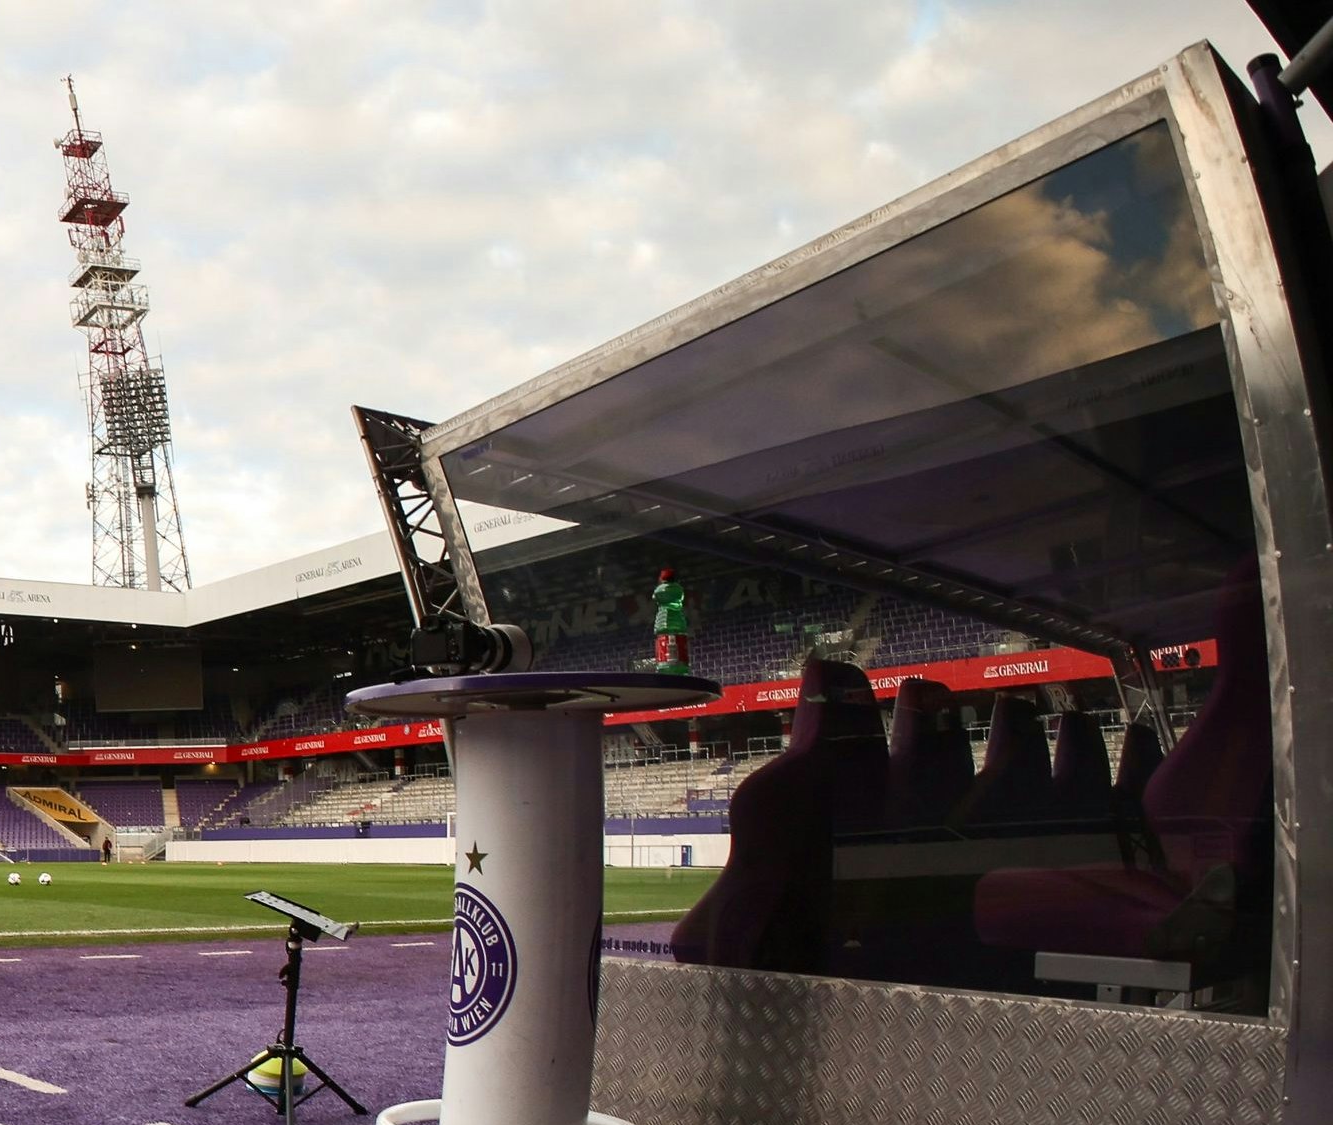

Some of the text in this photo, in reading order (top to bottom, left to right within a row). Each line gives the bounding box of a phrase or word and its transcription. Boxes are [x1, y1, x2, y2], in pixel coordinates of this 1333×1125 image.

[474, 514, 511, 533] GENERALI
[295, 556, 363, 583] GENERALI ARENA
[27, 593, 51, 604] ARENA
[999, 659, 1049, 677] GENERALI
[303, 740, 325, 750] GENERALI
[362, 733, 386, 744] GENERALI
[30, 755, 57, 764] GENERALI
[104, 752, 135, 761] GENERALI
[183, 751, 214, 759] GENERALI
[22, 791, 87, 821] ADMIRAL
[622, 939, 648, 952] made
[650, 941, 661, 955] by
[491, 962, 503, 977] 11
[461, 997, 493, 1032] WIEN
